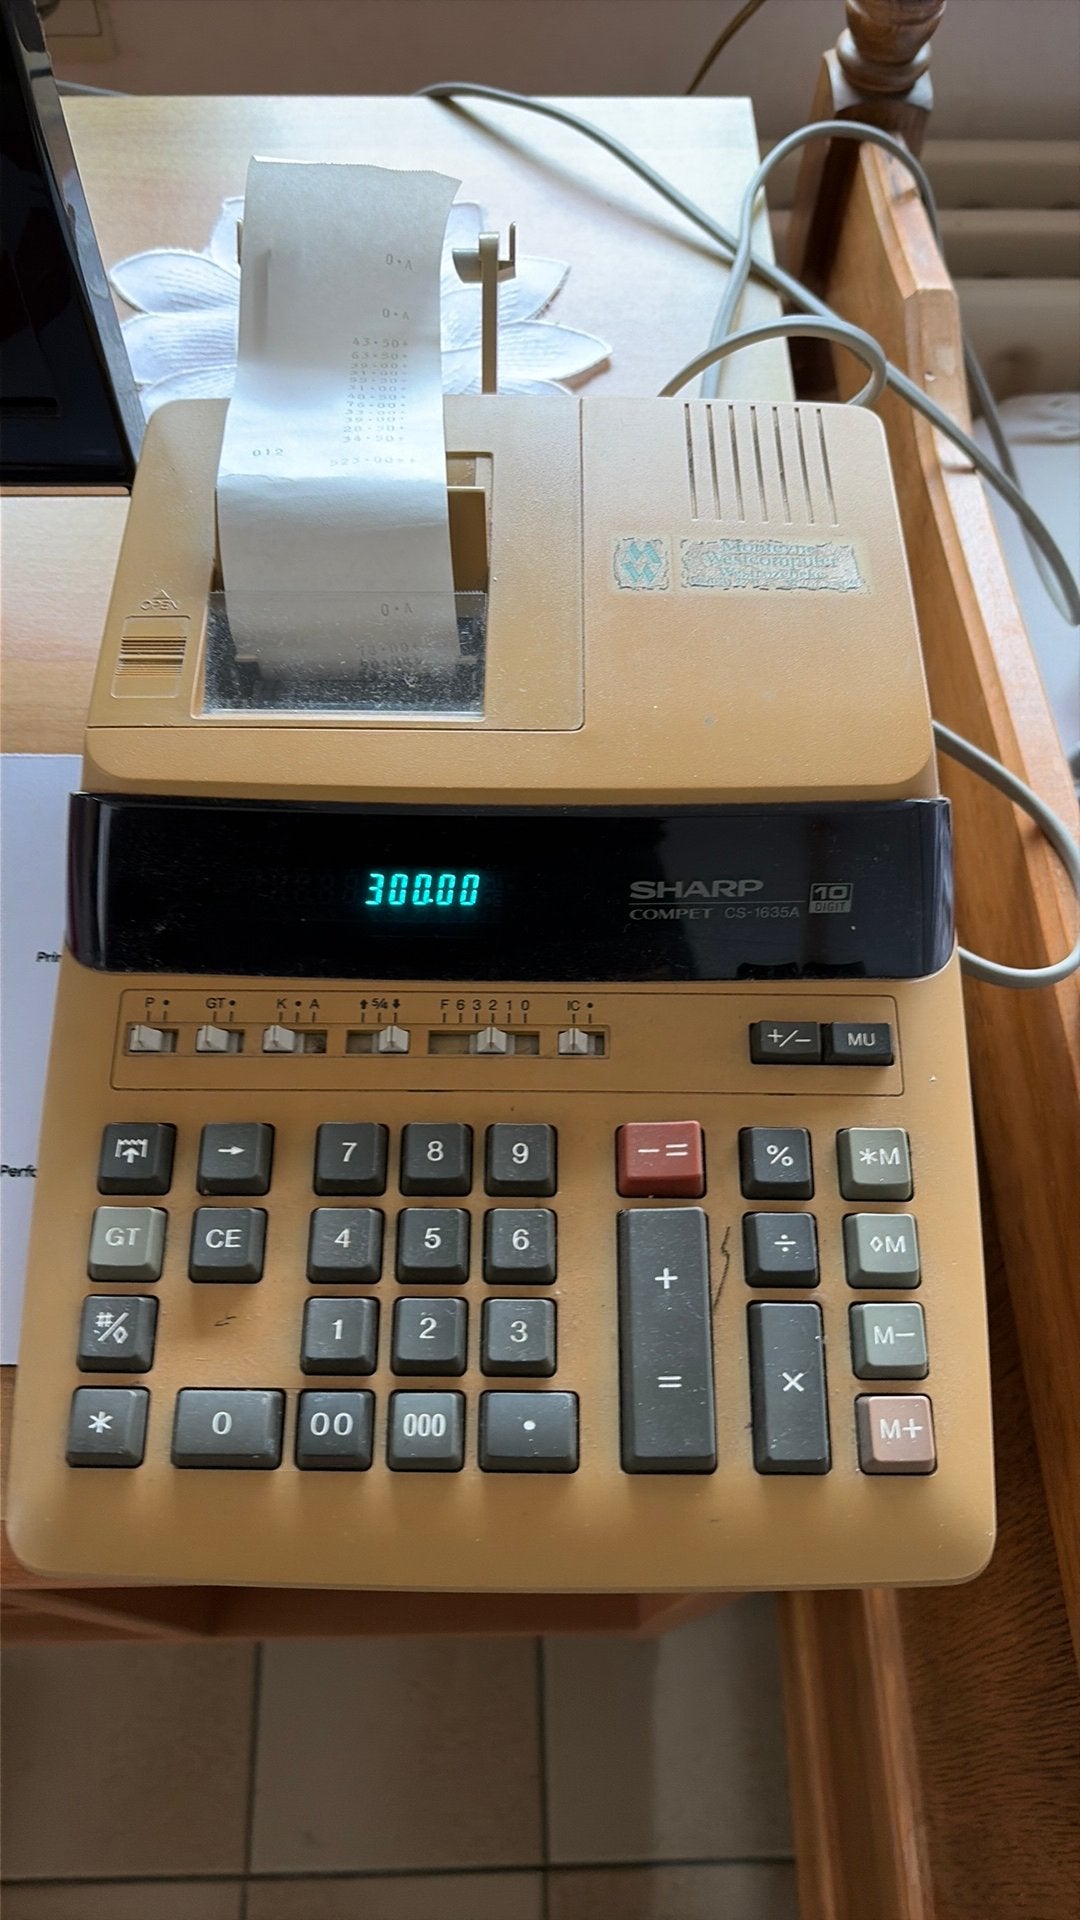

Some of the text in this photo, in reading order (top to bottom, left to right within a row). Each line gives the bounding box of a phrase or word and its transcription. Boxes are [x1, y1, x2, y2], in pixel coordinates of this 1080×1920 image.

[365, 873, 480, 905] 300.00
[629, 879, 847, 900] SHARP 10
[629, 901, 845, 920] COMPET CS-1635A DIGIT
[145, 997, 155, 1008] P
[205, 997, 226, 1009] GT
[276, 998, 320, 1009] K A
[440, 999, 530, 1011] F 6 3 2 1 0
[567, 999, 580, 1011] IC
[847, 1032, 876, 1047] MU
[341, 1142, 358, 1163] 7
[426, 1140, 444, 1162] 8
[511, 1142, 530, 1164] 9
[766, 1144, 794, 1167] %
[104, 1226, 141, 1247] GT
[205, 1228, 242, 1248] CE
[333, 1228, 352, 1248] 4
[423, 1227, 442, 1249] 5
[512, 1228, 531, 1251] 6
[331, 1319, 343, 1340] 1
[418, 1317, 437, 1339] 2
[510, 1320, 529, 1342] 3
[211, 1411, 232, 1435] 0
[310, 1412, 353, 1436] 00
[403, 1413, 447, 1437] 000
[879, 1418, 923, 1440] M+
